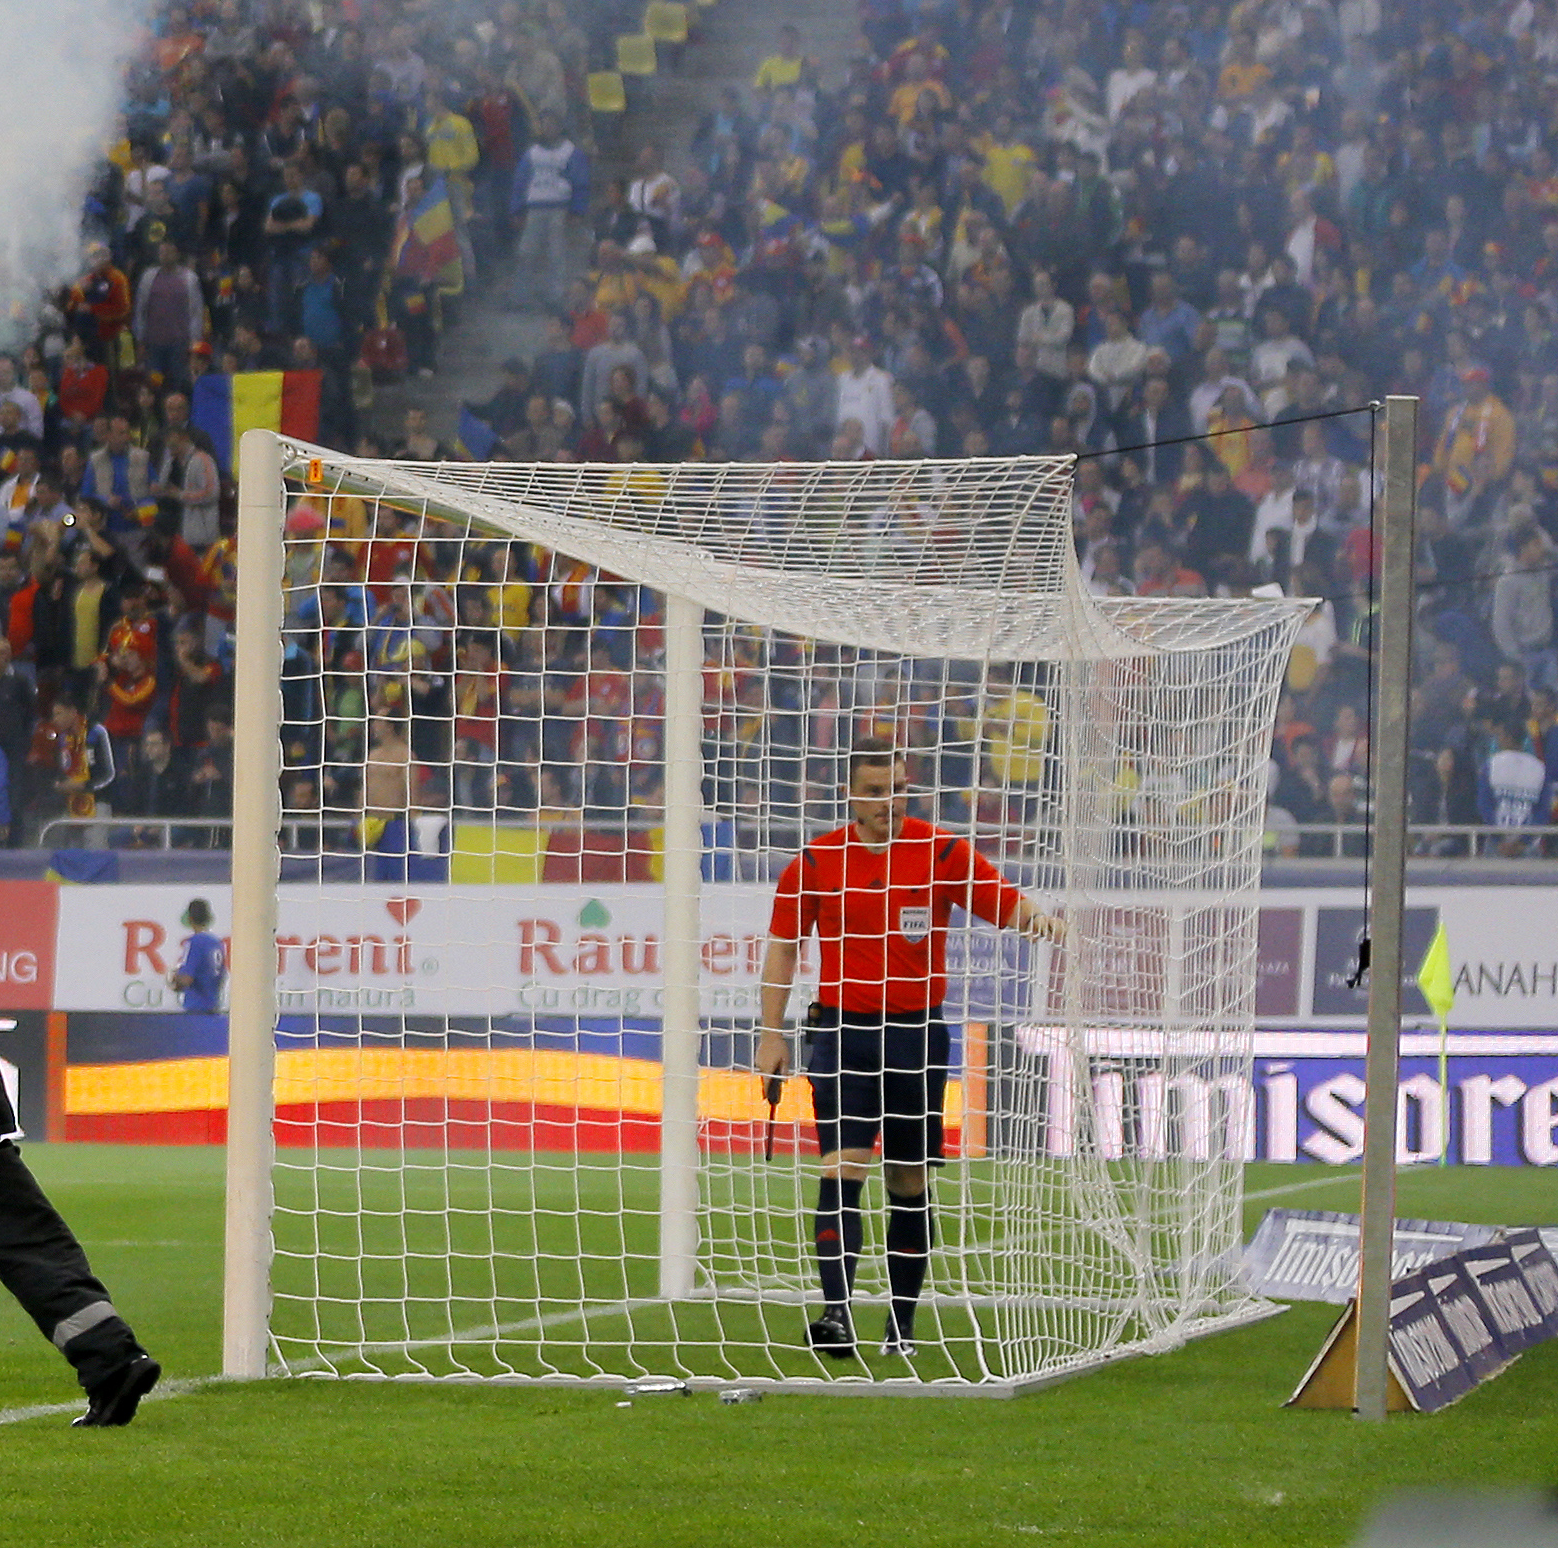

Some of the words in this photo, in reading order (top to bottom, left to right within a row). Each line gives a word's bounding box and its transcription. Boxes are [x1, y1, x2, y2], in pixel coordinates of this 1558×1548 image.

[1454, 962, 1558, 997] ANAH
[123, 981, 163, 1008] Cu
[520, 981, 559, 1008] Cu
